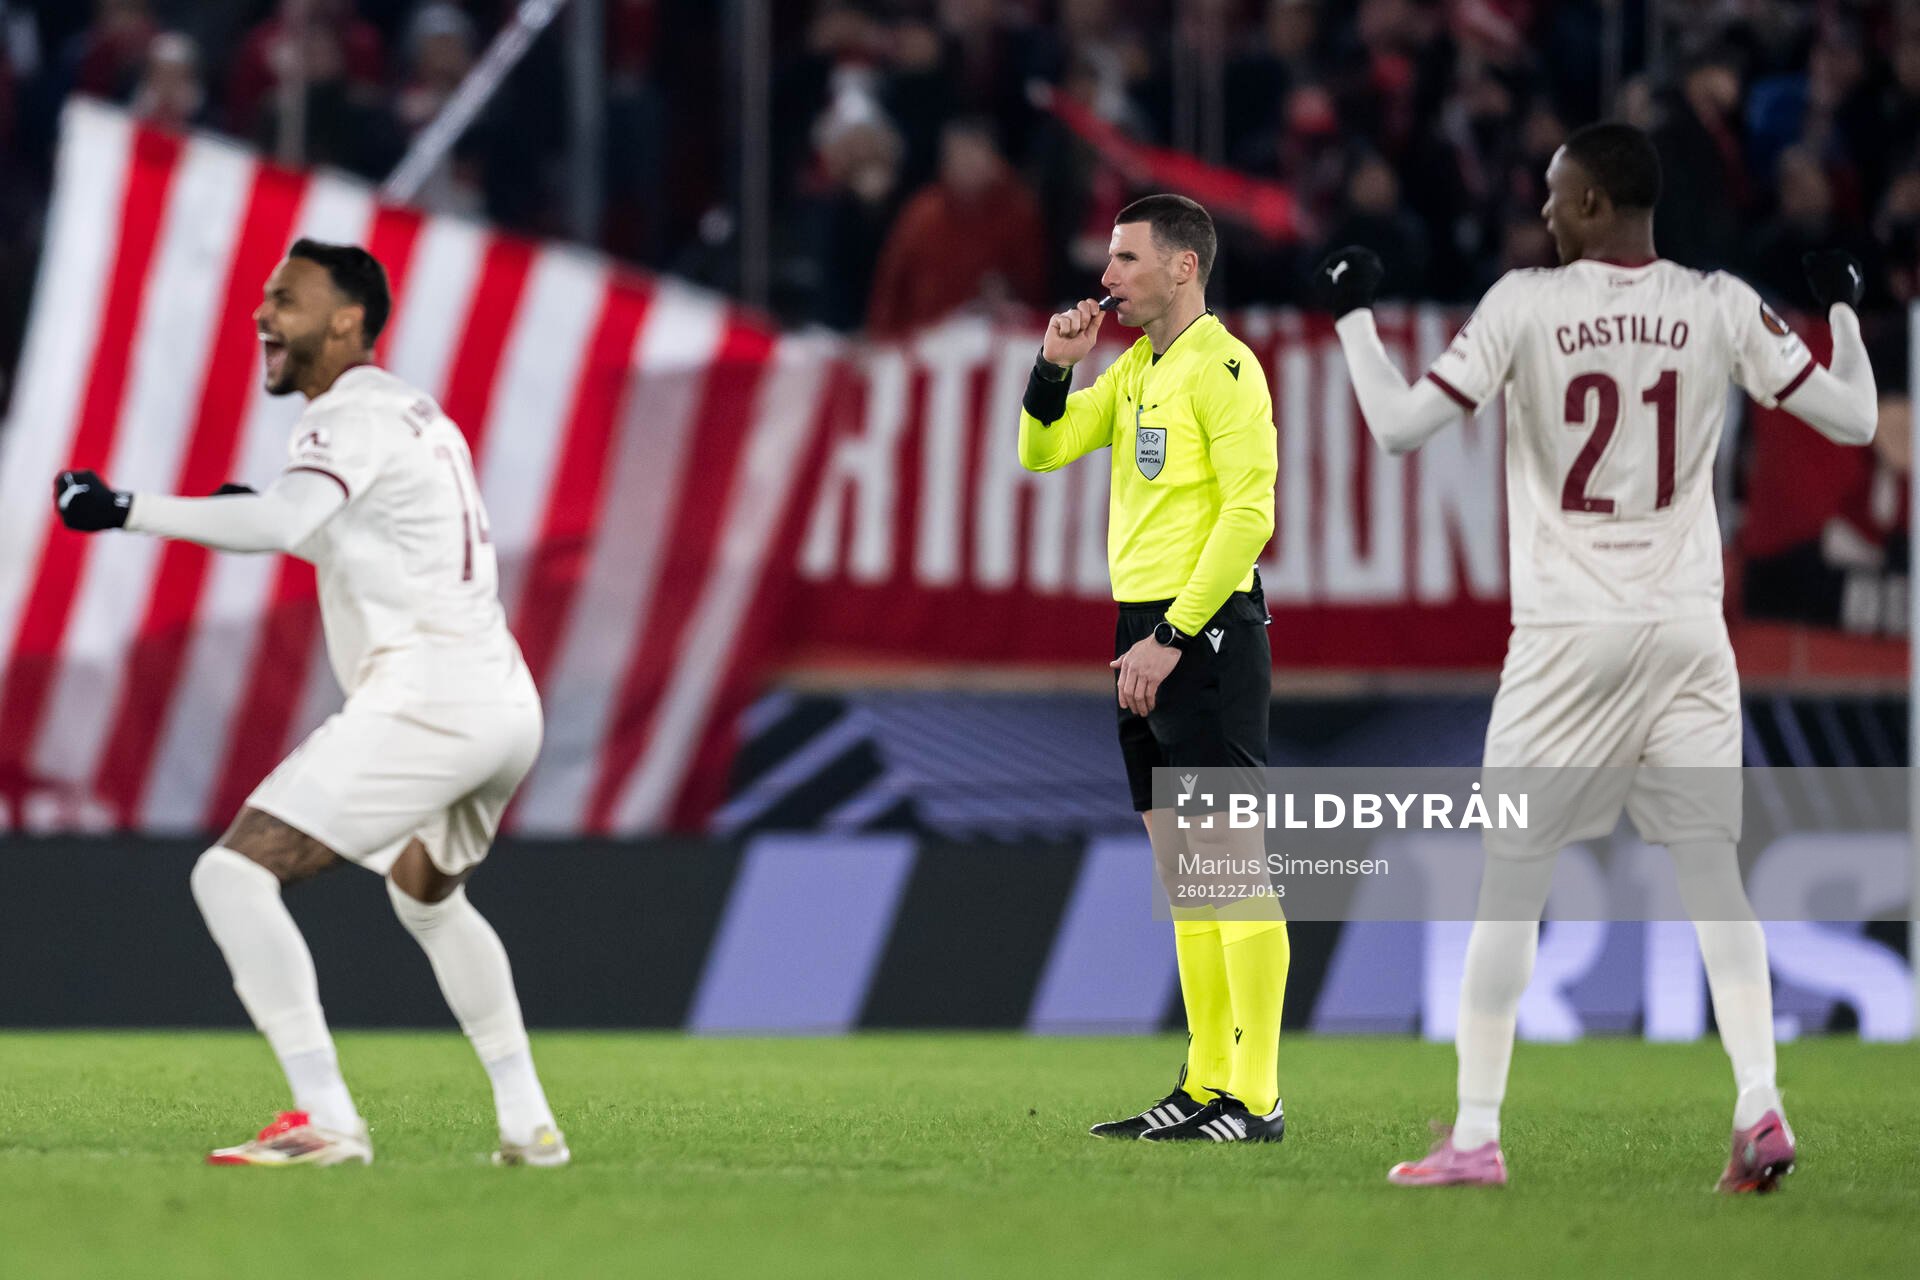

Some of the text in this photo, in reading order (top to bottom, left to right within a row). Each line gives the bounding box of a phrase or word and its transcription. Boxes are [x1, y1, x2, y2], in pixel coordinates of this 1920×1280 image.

[1556, 313, 1690, 356] CASTILLO
[1140, 433, 1159, 444] UEFA
[1561, 369, 1678, 515] 21
